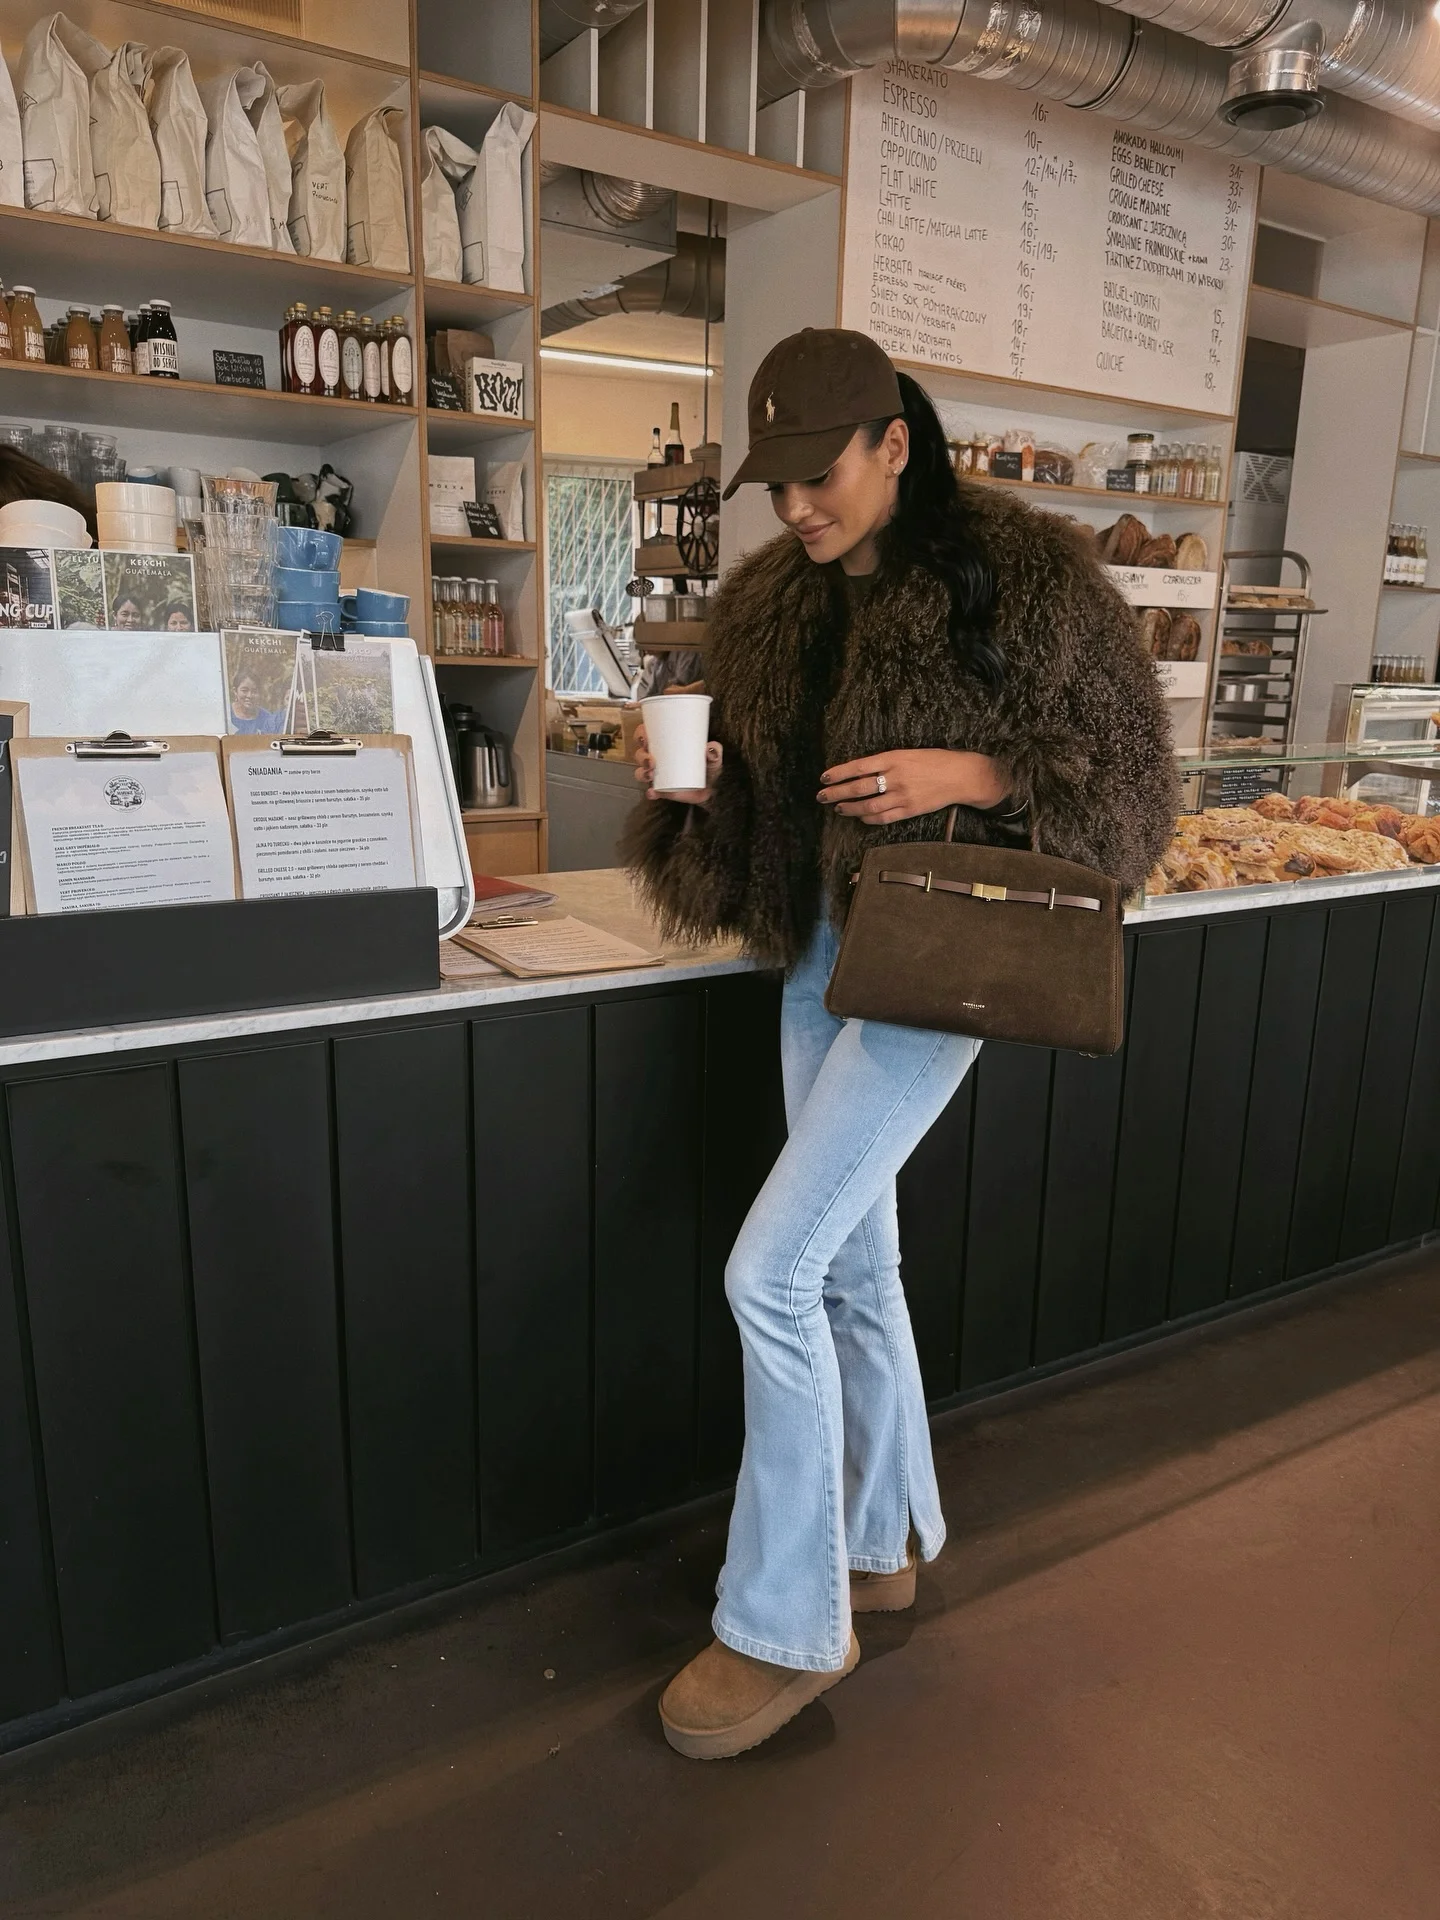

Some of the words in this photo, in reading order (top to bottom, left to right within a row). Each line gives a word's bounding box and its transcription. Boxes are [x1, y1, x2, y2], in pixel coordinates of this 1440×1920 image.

[884, 60, 948, 88] SHAKERATO
[883, 79, 937, 118] ESPRESSO
[881, 140, 937, 171] CAPPUCCINO
[1113, 129, 1147, 150] AWOKADO
[1150, 139, 1184, 163] HALLOUMI
[1112, 146, 1132, 165] EGGS
[1134, 154, 1176, 179] BENEDICT
[881, 165, 904, 189] FLAT
[909, 174, 937, 198] WHITE
[1110, 166, 1138, 190] GRILLED
[1138, 177, 1164, 197] CHEESE
[880, 189, 911, 211] LATTE
[1109, 188, 1138, 210] CROQUE
[1139, 198, 1171, 217] MADAME
[877, 208, 895, 226] CHAI
[964, 228, 988, 241] LATTE
[1108, 210, 1143, 231] CROISSANT
[1143, 220, 1148, 232] Z
[874, 230, 905, 252] KAKAO
[1106, 226, 1142, 251] ŚNIADANIE
[1145, 239, 1185, 264] FRANCUSKIE
[873, 254, 912, 276] HERBATA
[1105, 250, 1135, 270] TARTINE
[1136, 256, 1142, 270] Z
[1143, 260, 1184, 282] DODATKAMI
[1187, 271, 1197, 284] DO
[873, 272, 909, 288] ESPRESSO
[913, 282, 936, 294] TONIC
[870, 301, 884, 316] ON
[902, 294, 919, 309] SOK
[153, 358, 161, 368] OD
[162, 358, 177, 369] SERCA
[912, 344, 925, 356] NA
[930, 349, 963, 364] WYNOS
[1096, 351, 1125, 372] QUICHE
[125, 568, 172, 577] GUATEMALA
[130, 558, 166, 568] KEKCHI
[25, 603, 54, 619] CUP
[244, 646, 287, 655] GUATEMALA
[249, 638, 282, 646] KEKCHI
[248, 766, 283, 776] ŚNIADANIA
